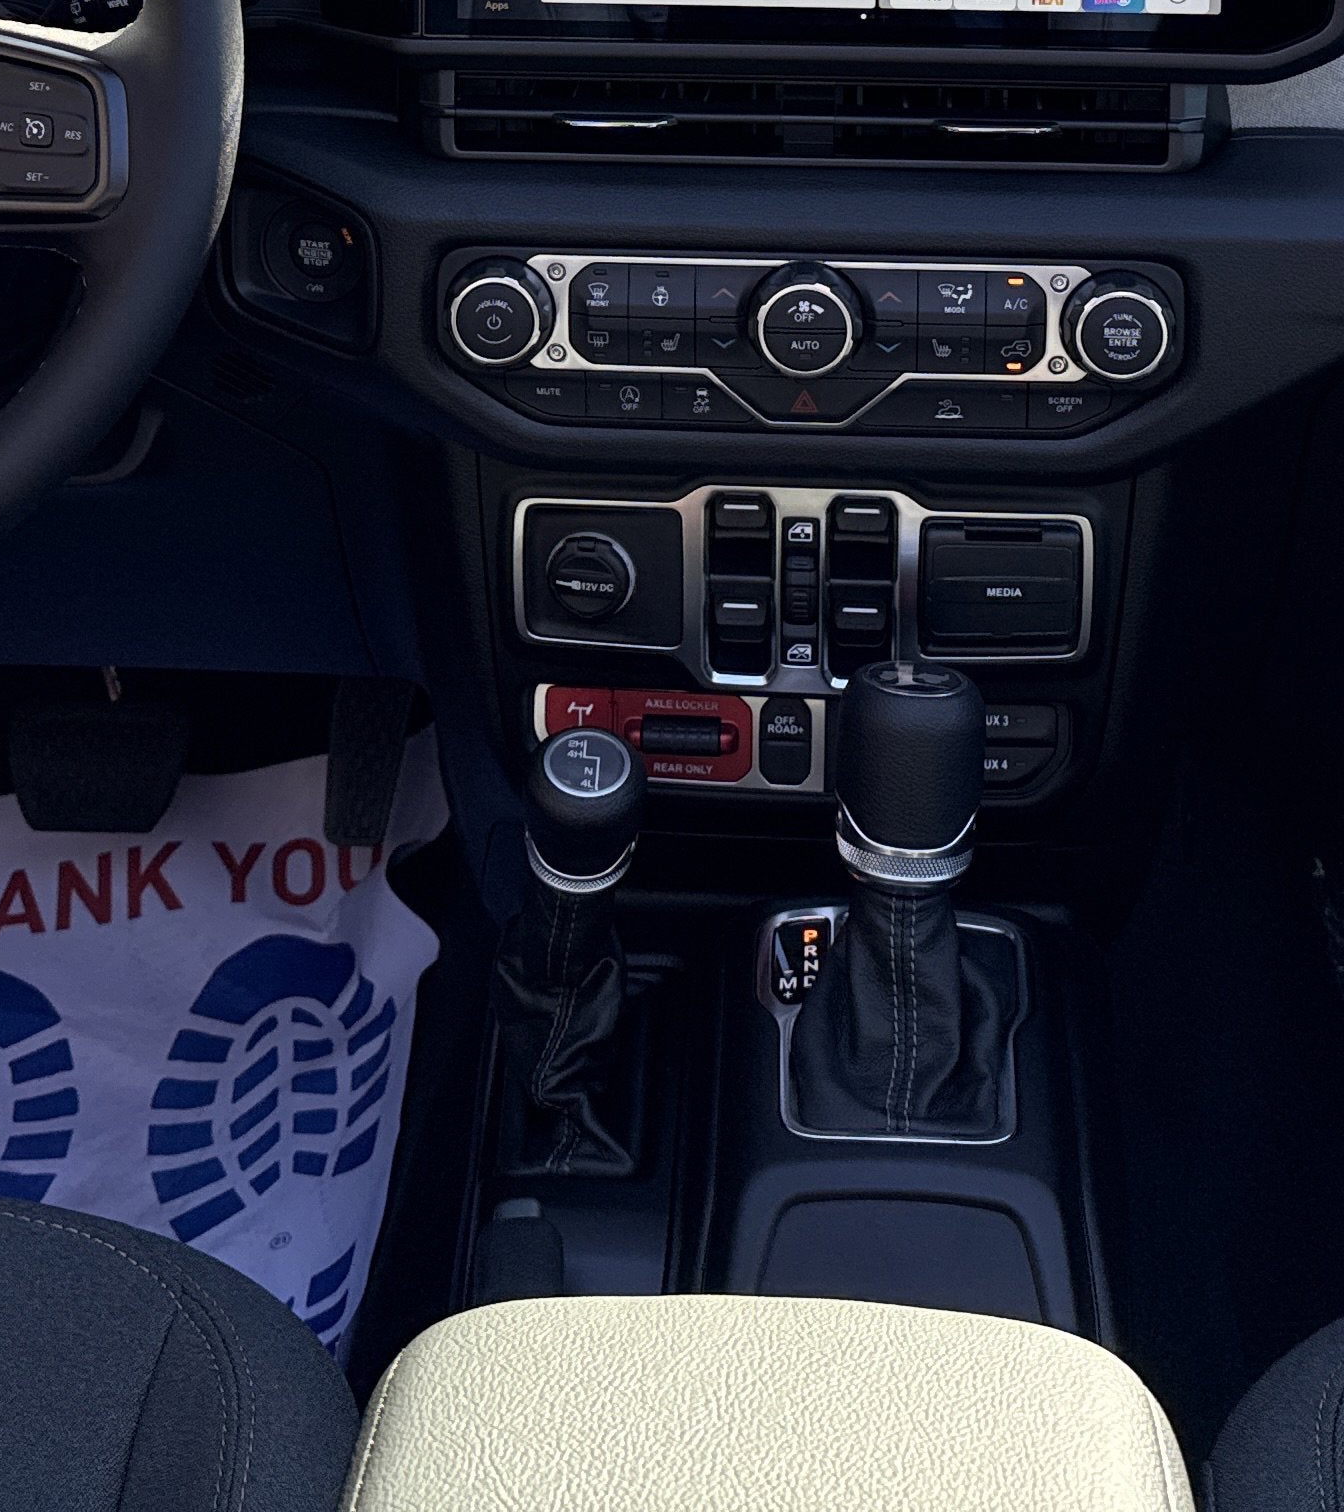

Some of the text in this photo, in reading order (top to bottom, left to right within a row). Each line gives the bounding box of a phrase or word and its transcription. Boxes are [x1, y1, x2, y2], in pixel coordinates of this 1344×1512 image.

[484, 1, 509, 11] Apps
[64, 131, 82, 141] RES
[299, 239, 331, 250] START
[303, 257, 330, 266] STOP
[479, 299, 509, 310] VOLUME
[1004, 299, 1028, 310] A/C
[944, 306, 966, 314] MODE
[794, 312, 815, 323] OFF
[1113, 313, 1134, 322] TUNE
[1103, 328, 1141, 336] BROWSE
[791, 340, 820, 350] AUTO
[1108, 339, 1138, 347] ENTER
[1108, 352, 1137, 361] SCROLL
[536, 388, 561, 396] MUTE
[621, 403, 639, 411] OFF
[693, 406, 710, 414] OFF
[581, 582, 614, 592] 12V DC
[986, 588, 1022, 597] MEDIA
[645, 698, 719, 710] AXLE LOCKER
[774, 716, 795, 725] OFF
[985, 715, 1009, 726] UX 3
[767, 724, 804, 734] ROAD+
[567, 739, 584, 748] 2H
[567, 749, 583, 758] 4H
[653, 762, 712, 775] REAR ONLY
[984, 759, 1008, 770] UX 4
[584, 767, 593, 776] N
[580, 779, 593, 788] 4L
[803, 929, 818, 943] P
[803, 944, 818, 958] R
[803, 959, 819, 972] N
[779, 976, 798, 991] M
